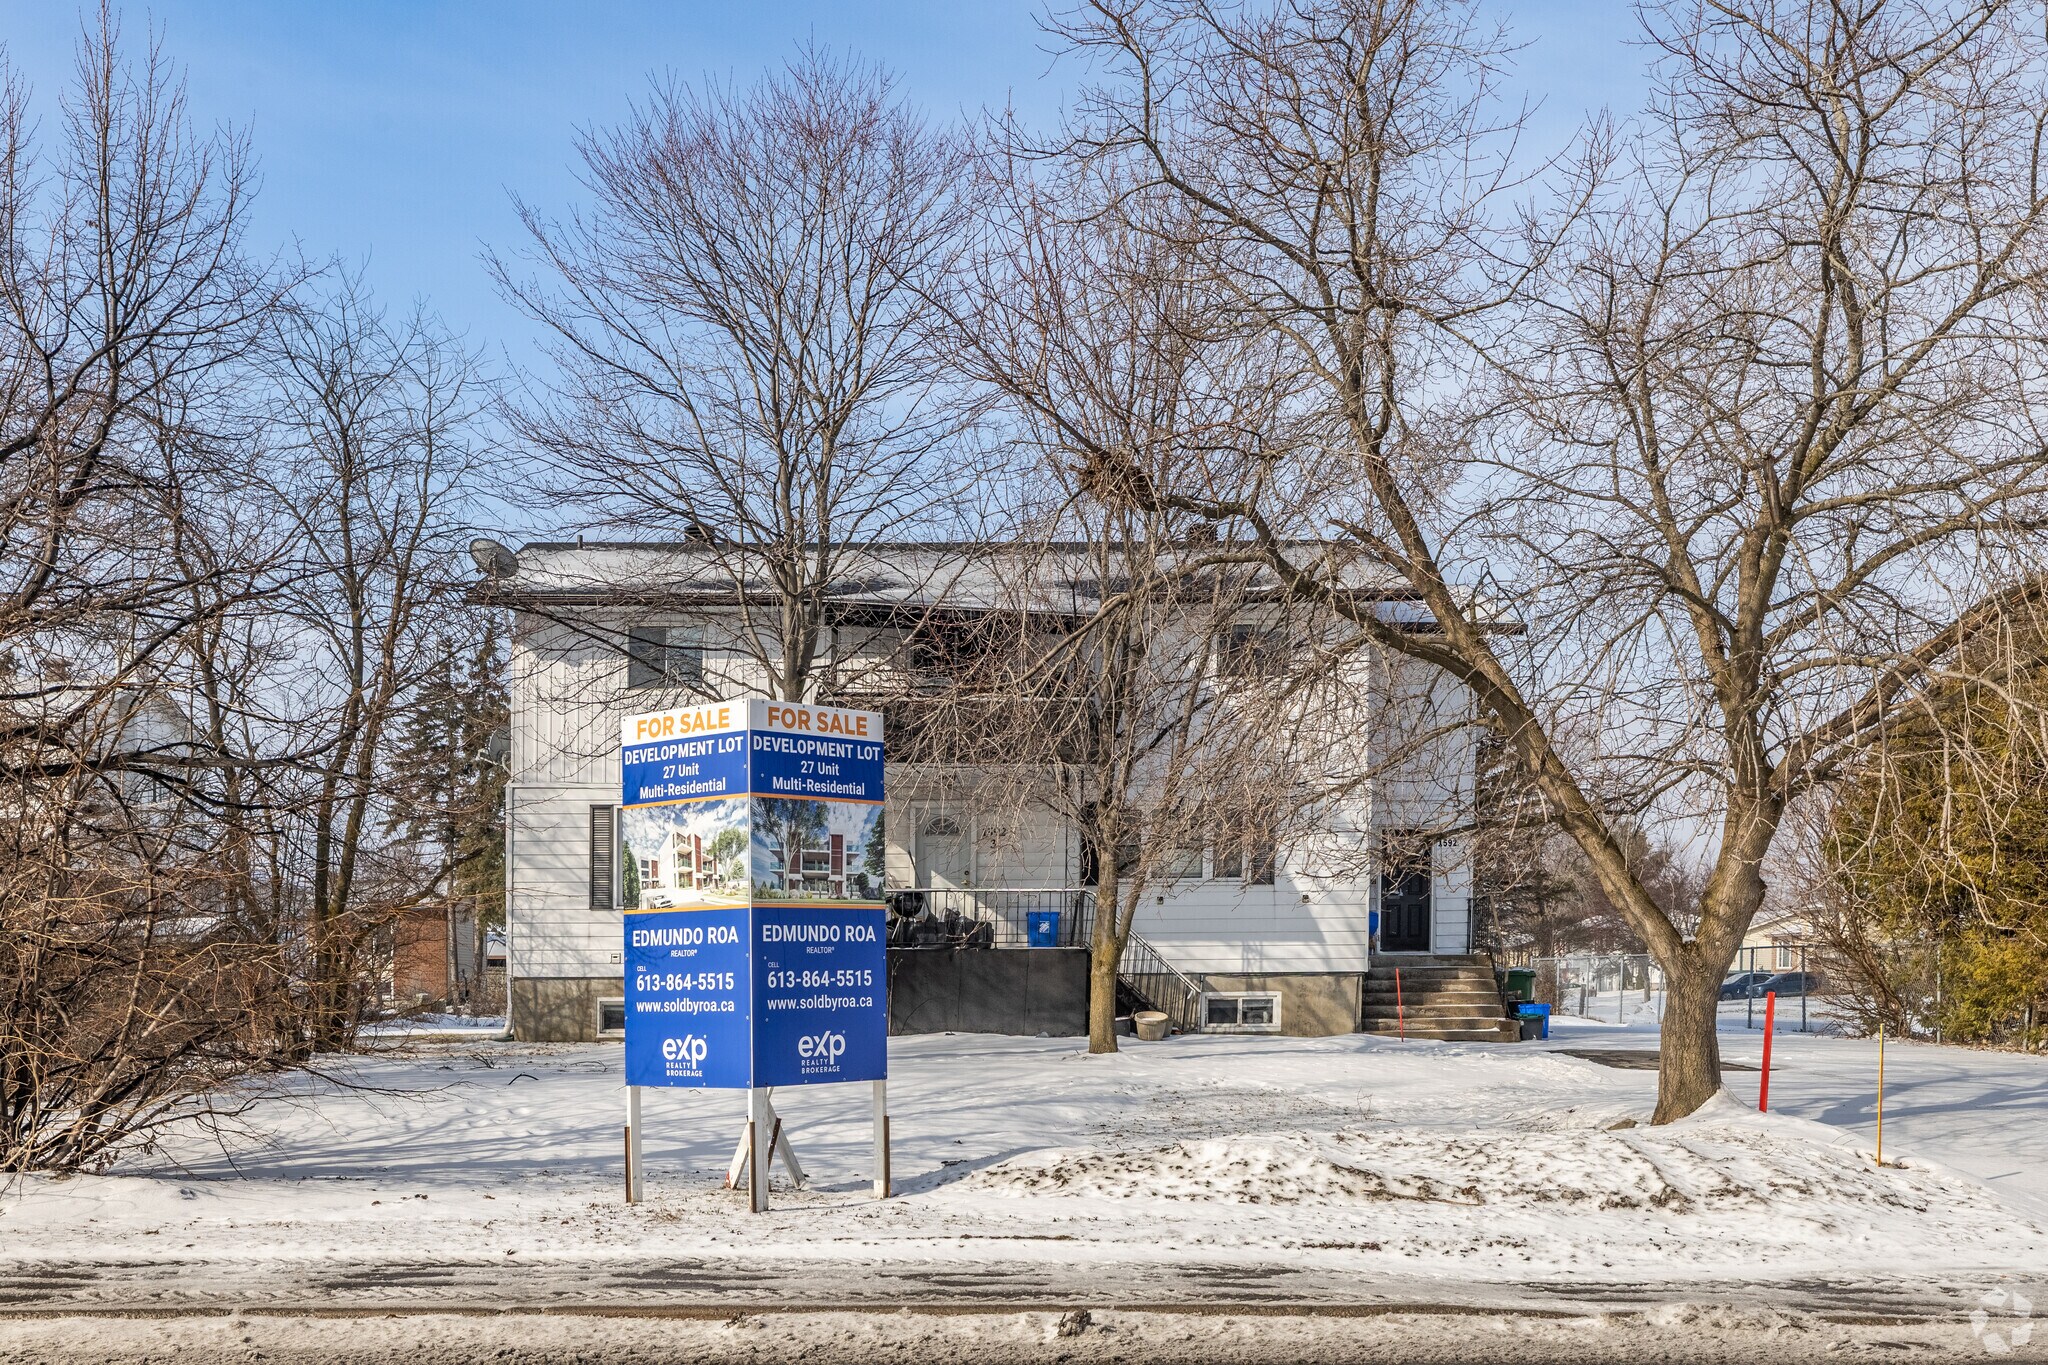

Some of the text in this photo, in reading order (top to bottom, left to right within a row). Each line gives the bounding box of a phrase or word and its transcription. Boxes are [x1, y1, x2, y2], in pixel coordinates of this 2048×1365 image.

[637, 707, 730, 740] FOR SALE
[768, 706, 868, 736] FOR SALE
[624, 735, 744, 766] DEVELOPMENT LOT
[753, 735, 881, 761] DEVELOPMENT LOT
[663, 763, 700, 779] 27 Unit
[801, 760, 840, 776] 27 Unit
[640, 777, 726, 799] Multi-Residential
[772, 776, 865, 796] Multi-Residential
[1438, 839, 1457, 847] 1592
[632, 926, 739, 947] EDMUNDO ROA
[762, 924, 876, 943] EDMUNDO ROA
[636, 972, 734, 992] 613-864-5515
[767, 970, 872, 989] 613-864-5515
[636, 997, 735, 1015] www.soldbyroa.ca
[767, 994, 873, 1011] www.soldbyroa.ca
[666, 1069, 703, 1077] BROKERAGE
[801, 1065, 841, 1074] BROKERAGE
